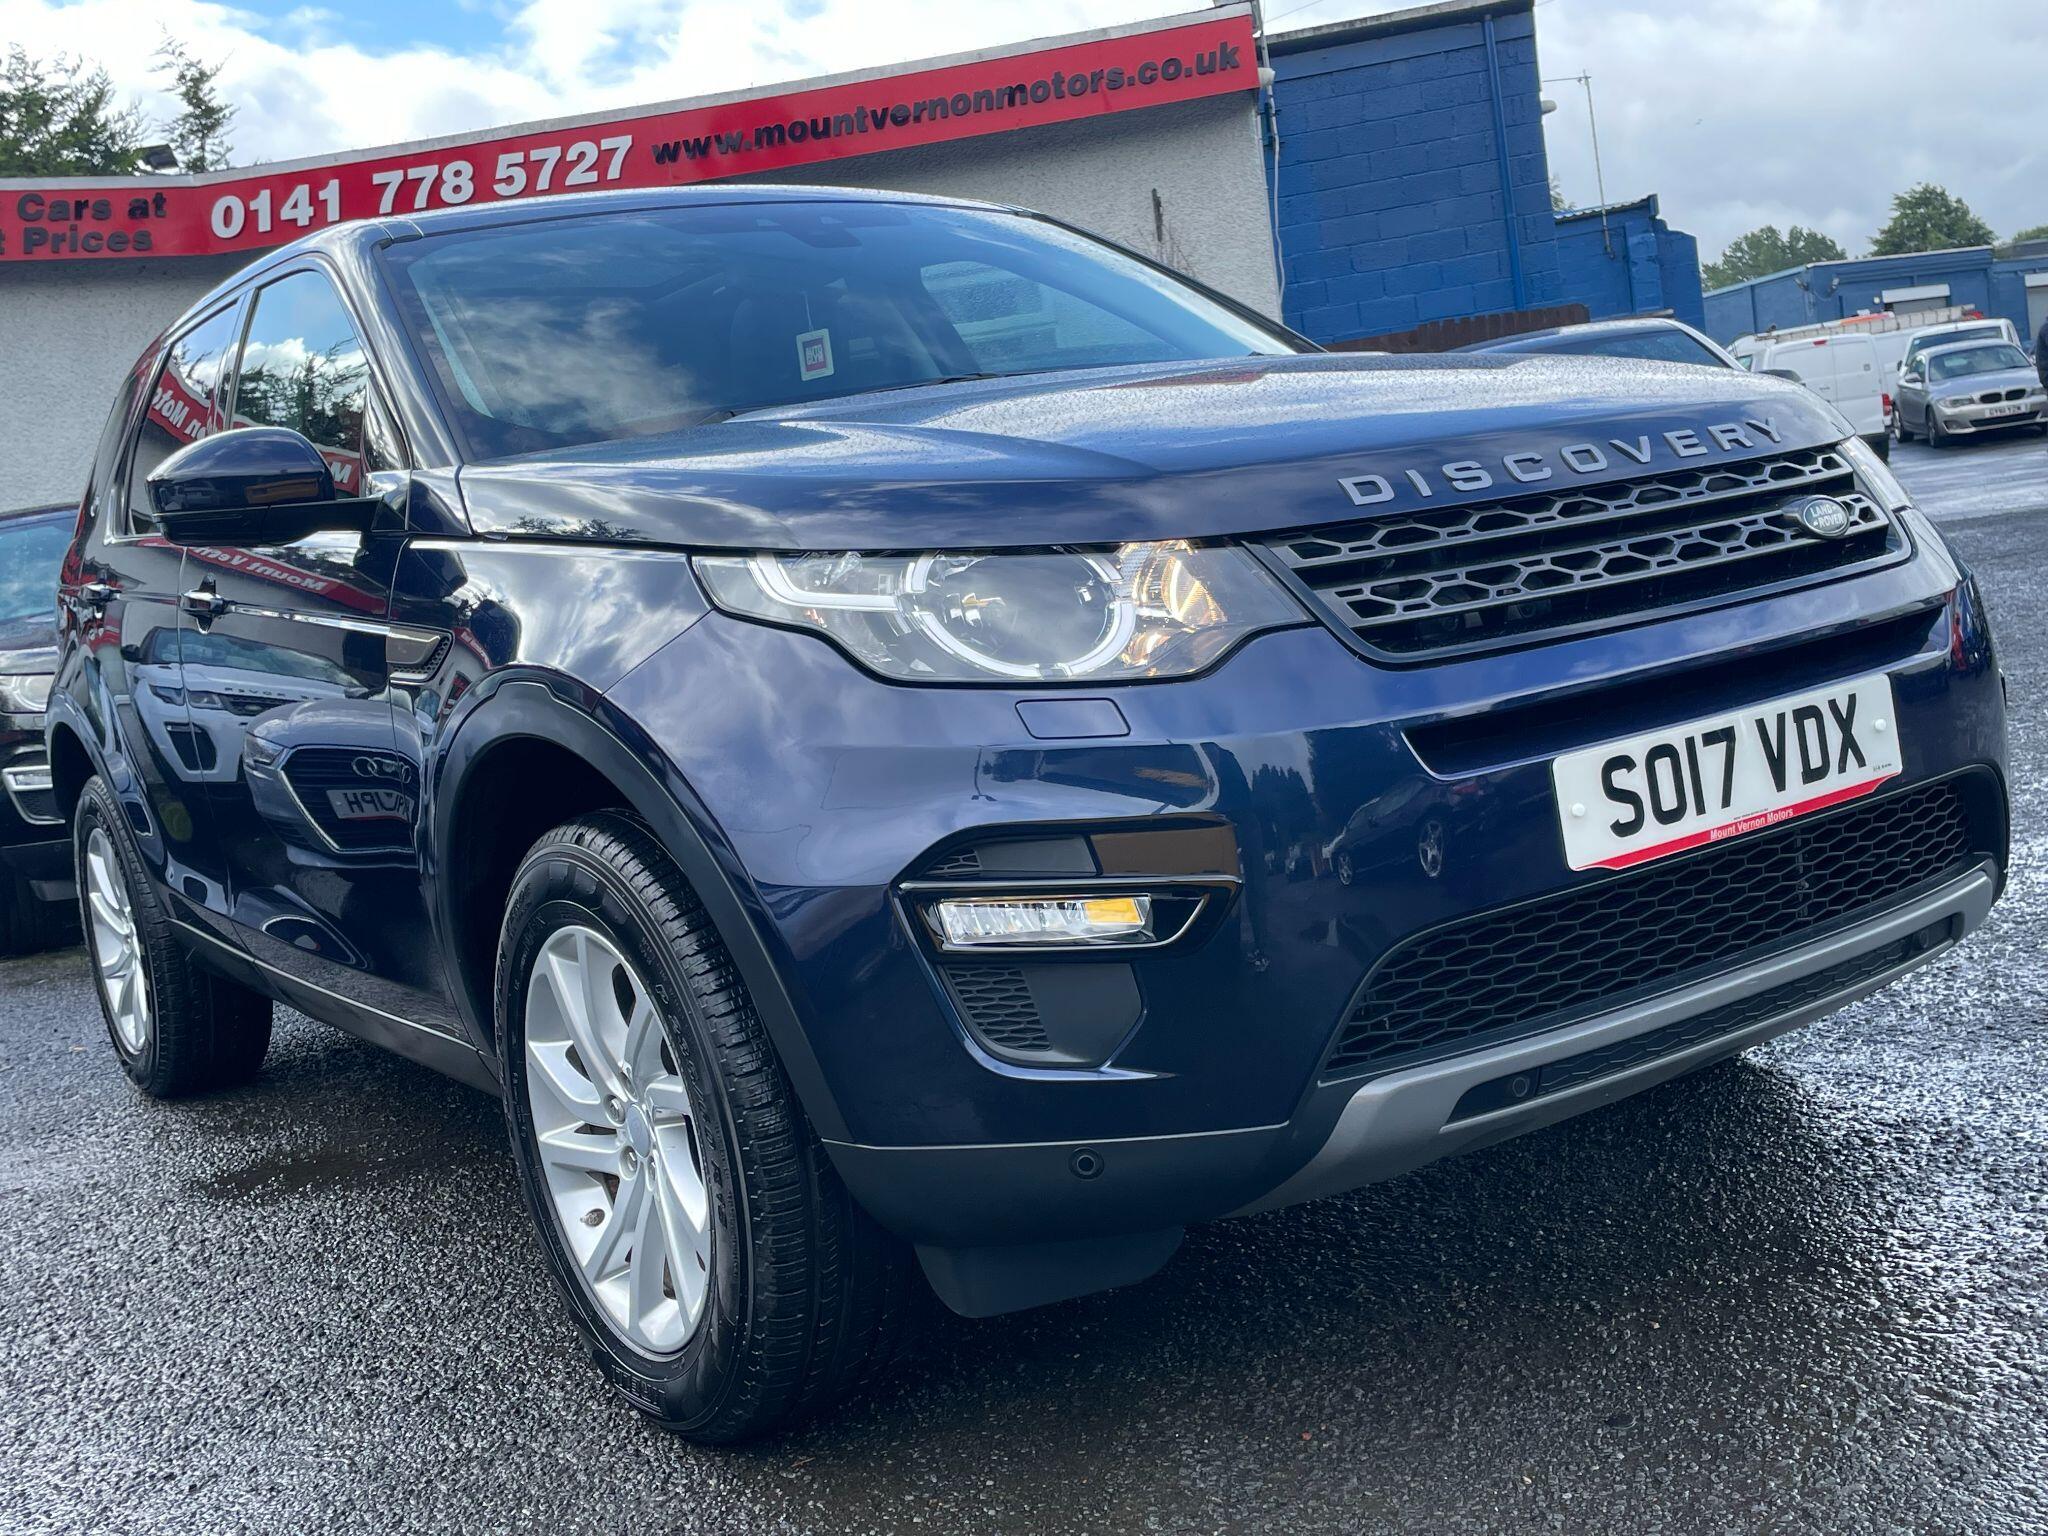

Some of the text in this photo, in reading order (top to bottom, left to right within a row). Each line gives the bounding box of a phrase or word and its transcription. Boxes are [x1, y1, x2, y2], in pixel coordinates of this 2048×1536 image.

[652, 42, 1240, 165] www.mountvernonmotors.co.uk
[211, 135, 633, 239] 0141 778 5727
[17, 192, 167, 222] Cars at
[23, 224, 153, 254] Prices
[1338, 417, 1783, 506] DISCOVERY
[1810, 504, 1833, 518] LAND
[1818, 513, 1845, 528] ROVER
[1601, 693, 1867, 838] SO17 VDX
[1710, 825, 1736, 841] Mount
[1737, 816, 1766, 833] Vernon
[1767, 807, 1794, 825] Motors
